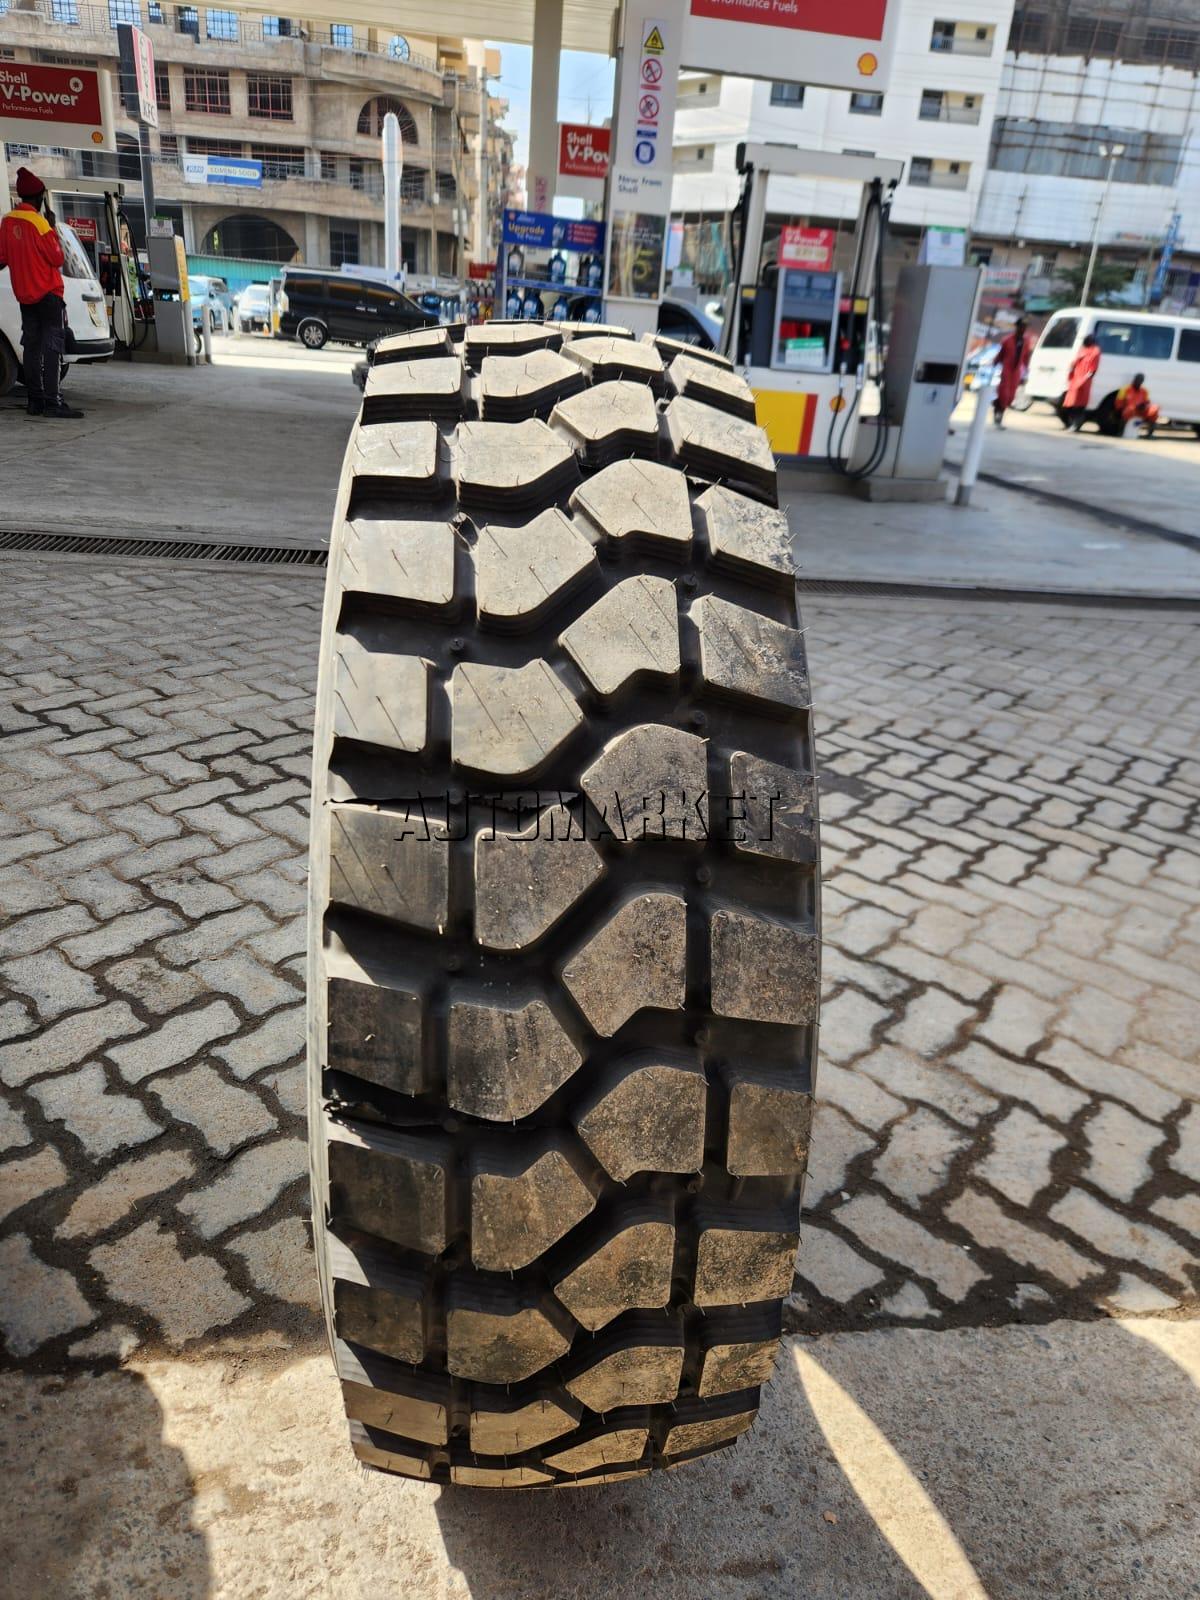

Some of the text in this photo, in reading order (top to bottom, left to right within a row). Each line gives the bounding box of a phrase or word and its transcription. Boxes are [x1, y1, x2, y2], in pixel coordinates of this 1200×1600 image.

[772, 0, 798, 13] Fuels
[0, 70, 28, 84] Shell
[1, 84, 79, 106] V-Power
[143, 101, 156, 121] KFC
[567, 132, 592, 145] Shell
